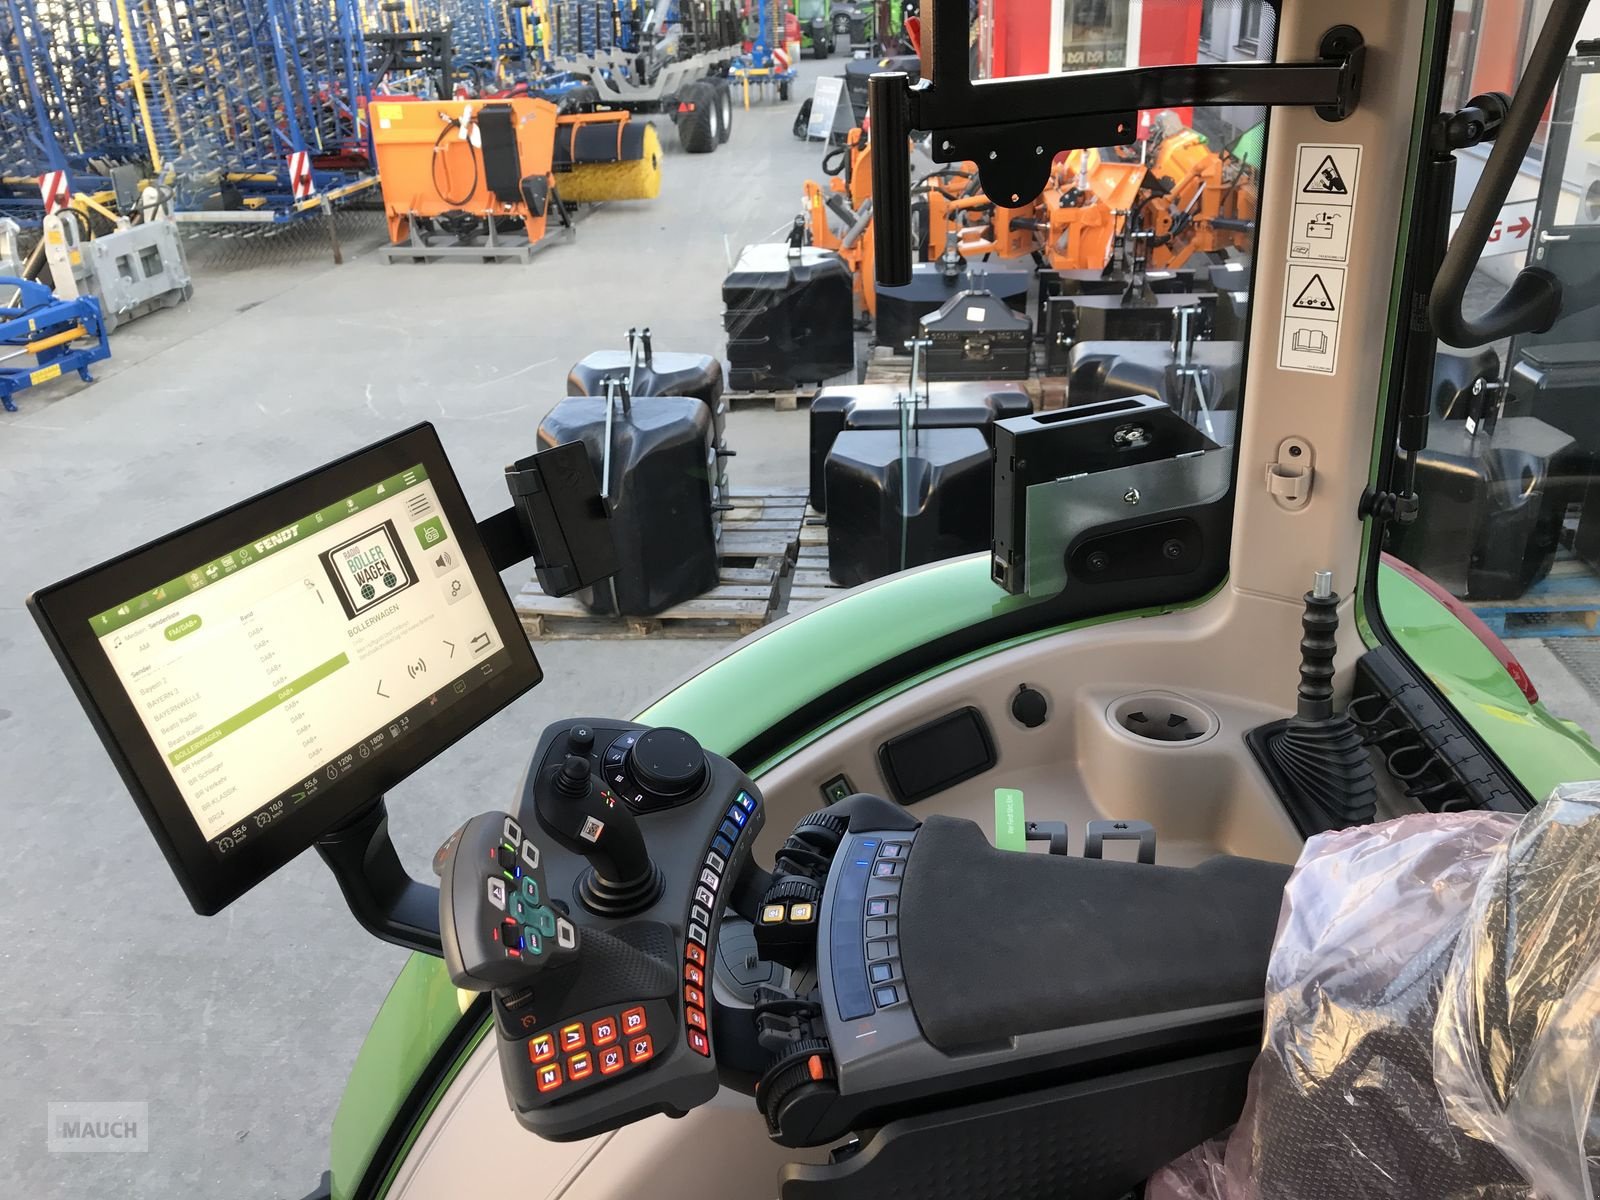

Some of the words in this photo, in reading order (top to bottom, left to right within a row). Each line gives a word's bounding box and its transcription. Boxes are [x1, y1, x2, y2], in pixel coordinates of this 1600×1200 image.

[255, 525, 301, 553] FENDT
[343, 547, 359, 559] RADIO
[347, 546, 383, 573] BOLLER
[354, 559, 390, 586] WAGEN
[148, 611, 179, 629] Senderliste
[240, 612, 253, 621] Band
[348, 604, 398, 637] BOLLERWAGEN
[138, 642, 150, 652] AM
[168, 619, 197, 637] FM/DAB+
[248, 626, 263, 637] DAB+
[254, 638, 269, 649] DAB+
[260, 651, 275, 662] DAB+
[131, 665, 151, 678] Sender
[266, 663, 281, 674] DAB+
[272, 675, 287, 686] DAB+
[278, 687, 293, 699] DAB+
[147, 692, 172, 709] BAYERN
[285, 699, 299, 711] DAB+
[154, 693, 200, 722] BAYERNWELLE
[161, 722, 177, 735] Beats
[179, 711, 196, 724] Radio
[290, 711, 305, 723] DAB+
[296, 723, 311, 735] DAB+
[168, 735, 184, 748] Beats
[186, 724, 203, 737] Radio
[302, 735, 317, 747] DAB+
[369, 733, 384, 746] 1800
[174, 730, 221, 761] BOLLERWAGEN
[308, 747, 322, 759] DAB+
[338, 754, 352, 767] 1200
[198, 761, 224, 781] Schlager
[204, 776, 227, 792] Verkehr
[304, 778, 318, 790] 55,6
[269, 800, 283, 813] 10,0
[208, 810, 224, 823] BR24
[232, 824, 247, 838] 55,6
[574, 1062, 587, 1070] TMS
[544, 1072, 554, 1083] N
